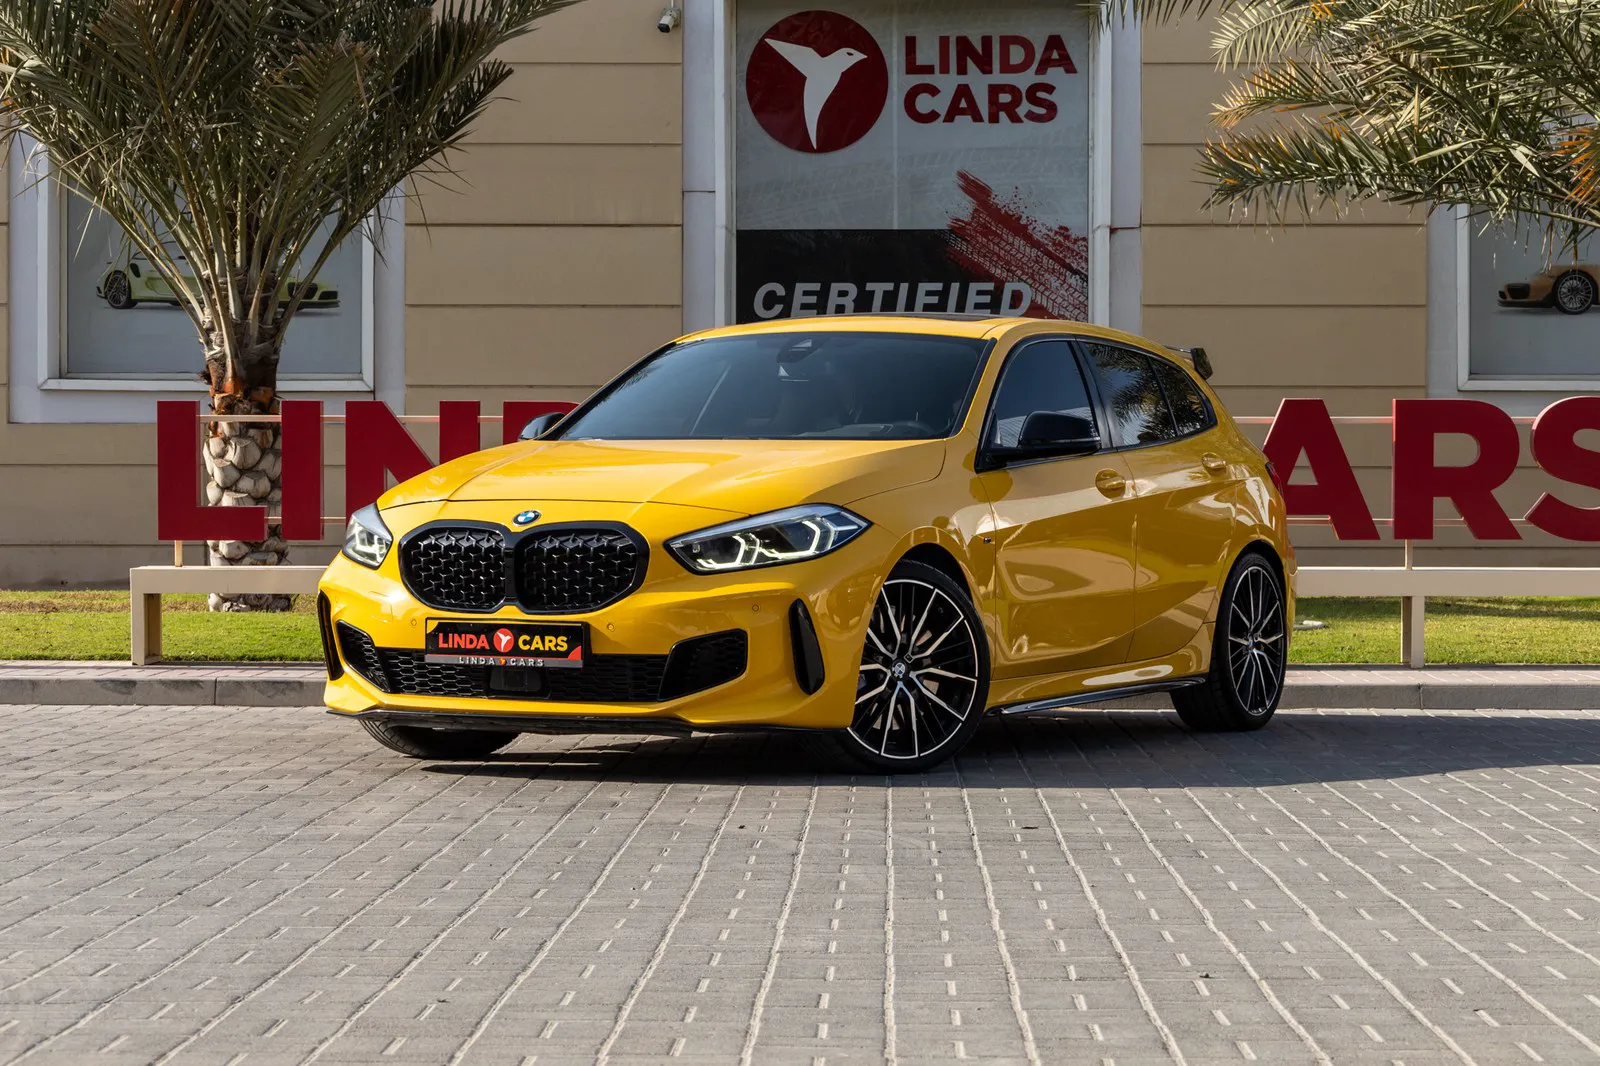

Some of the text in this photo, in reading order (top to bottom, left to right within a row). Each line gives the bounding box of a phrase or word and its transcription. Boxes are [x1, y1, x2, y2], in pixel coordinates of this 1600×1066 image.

[904, 34, 1077, 75] LINDA
[903, 82, 1058, 124] CARS
[753, 282, 1033, 318] CERTIFIED
[157, 396, 1600, 542] LIN ARS
[438, 633, 568, 651] LINDA CARS
[459, 657, 544, 666] LINDA CARS
